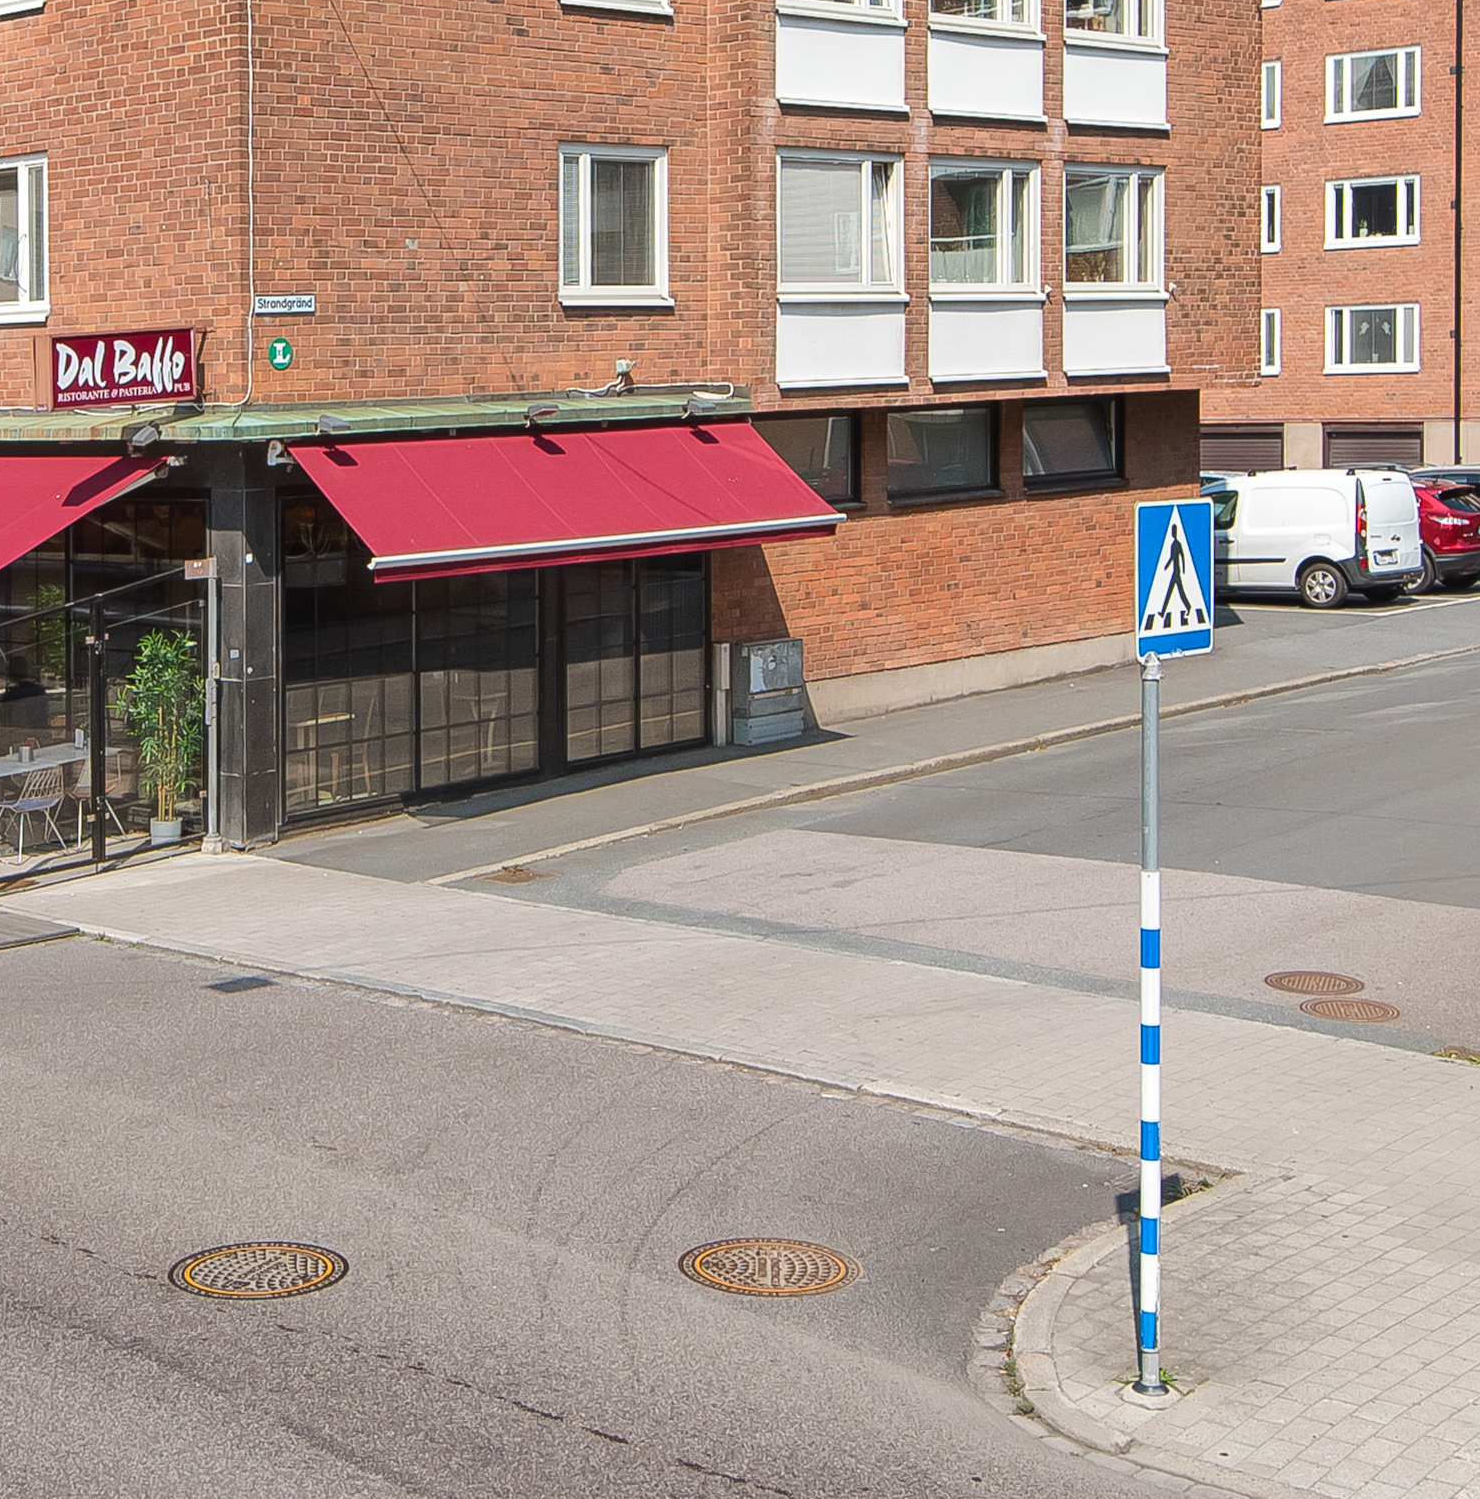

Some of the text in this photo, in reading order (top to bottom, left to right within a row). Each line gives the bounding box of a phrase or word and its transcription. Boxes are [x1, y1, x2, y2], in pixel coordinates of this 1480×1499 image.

[257, 297, 313, 311] Strandgränd
[56, 336, 185, 393] Dal Baffo
[57, 388, 109, 402] RISTORANTE
[119, 386, 156, 398] PASTERIA
[174, 383, 191, 393] PUB
